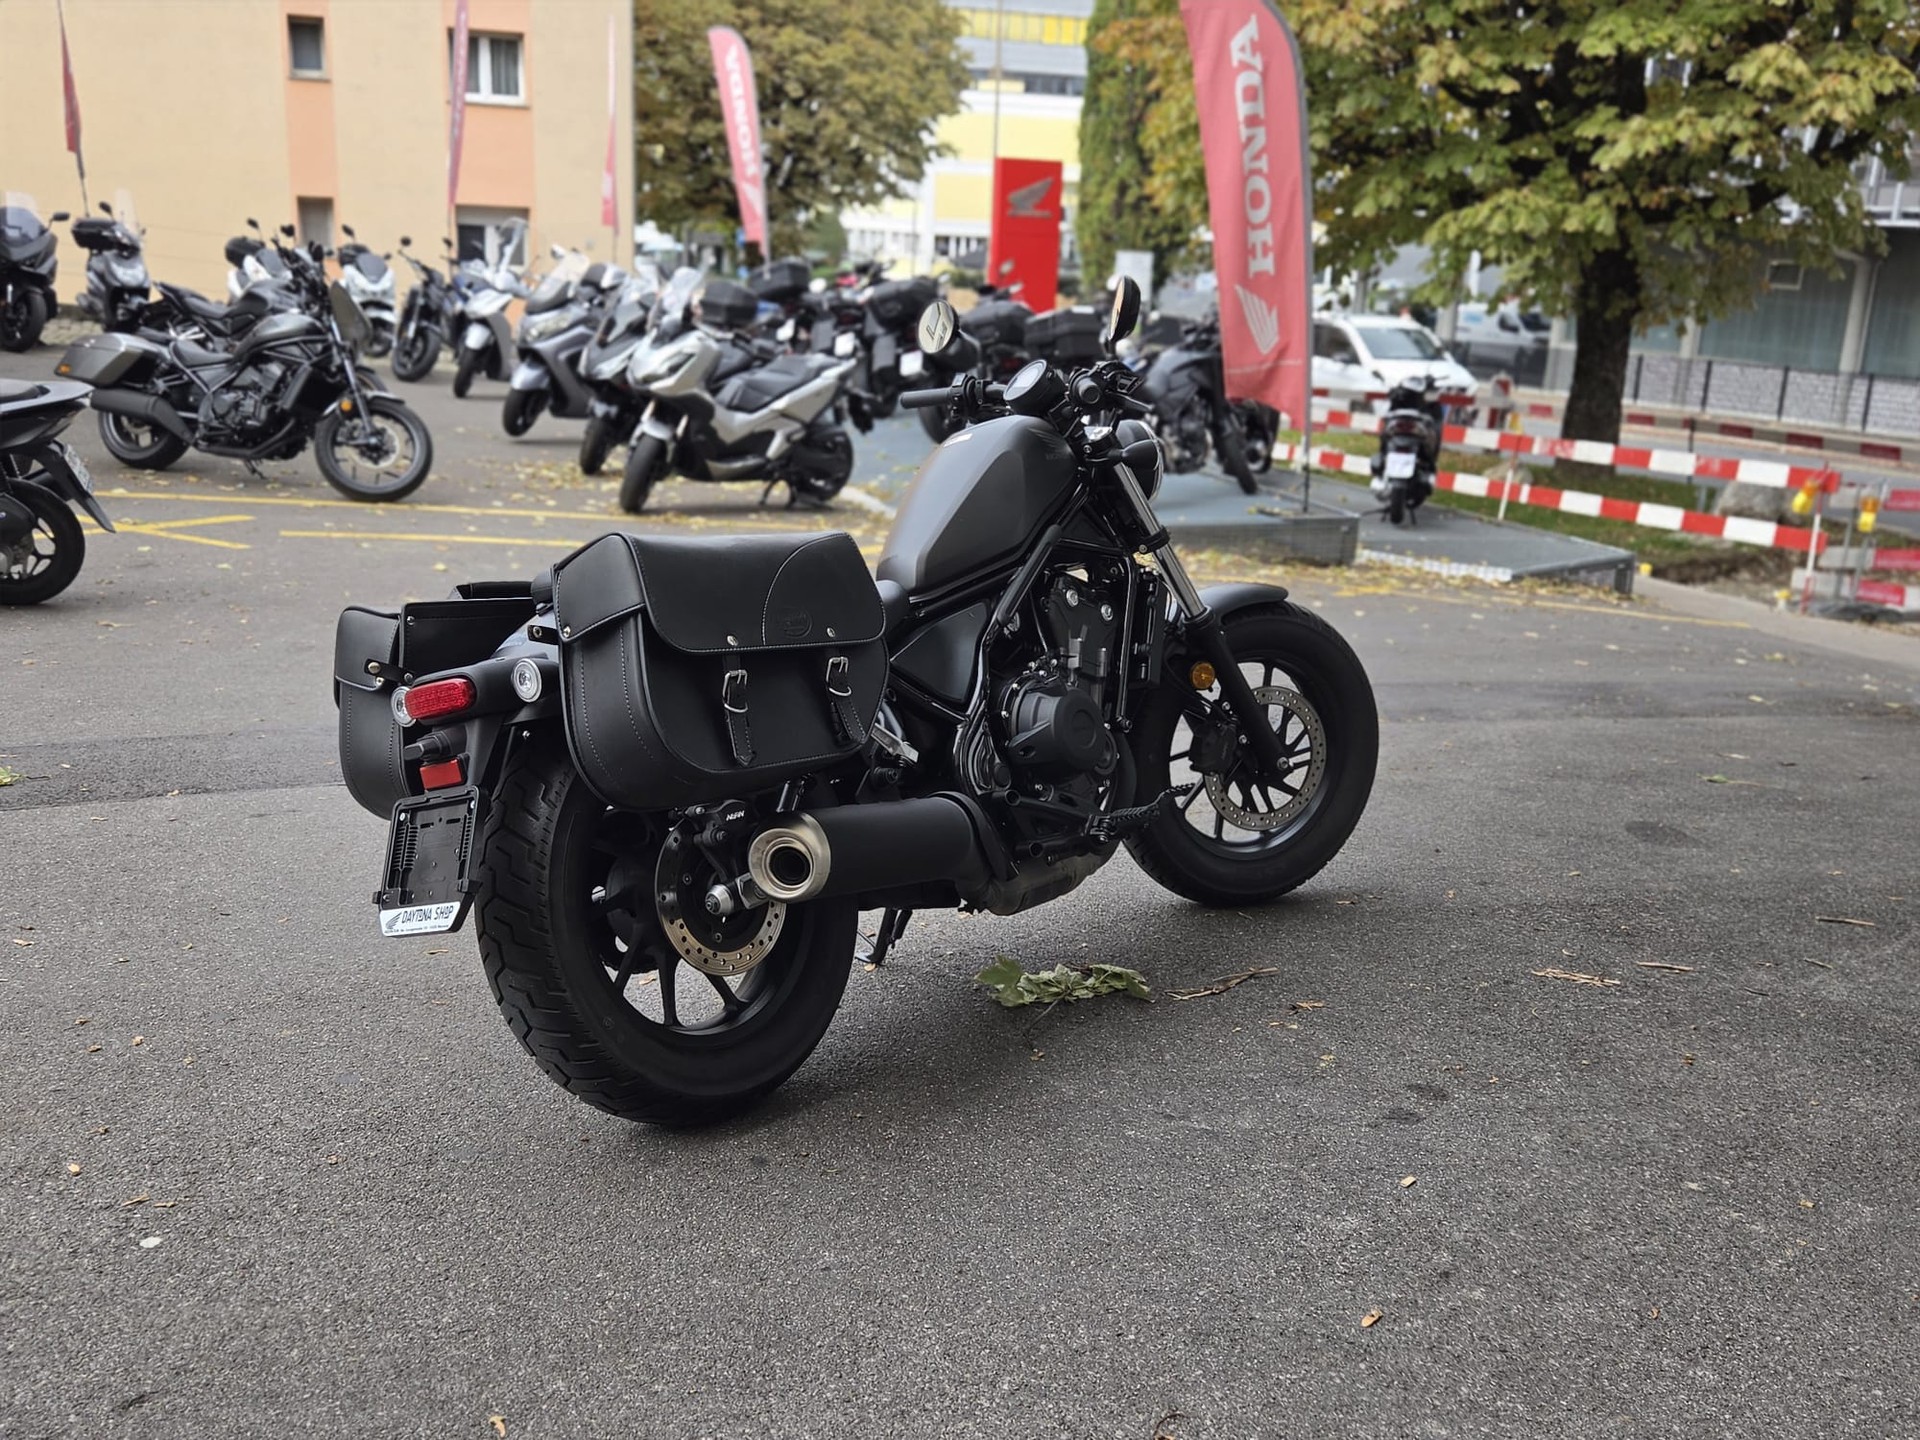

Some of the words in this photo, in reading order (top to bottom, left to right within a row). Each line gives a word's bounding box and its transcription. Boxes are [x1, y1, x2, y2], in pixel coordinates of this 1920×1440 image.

[725, 45, 757, 176] HONDA
[1230, 14, 1275, 278] HONDA
[401, 908, 433, 924] DAYTONA
[434, 905, 454, 920] SHOP
